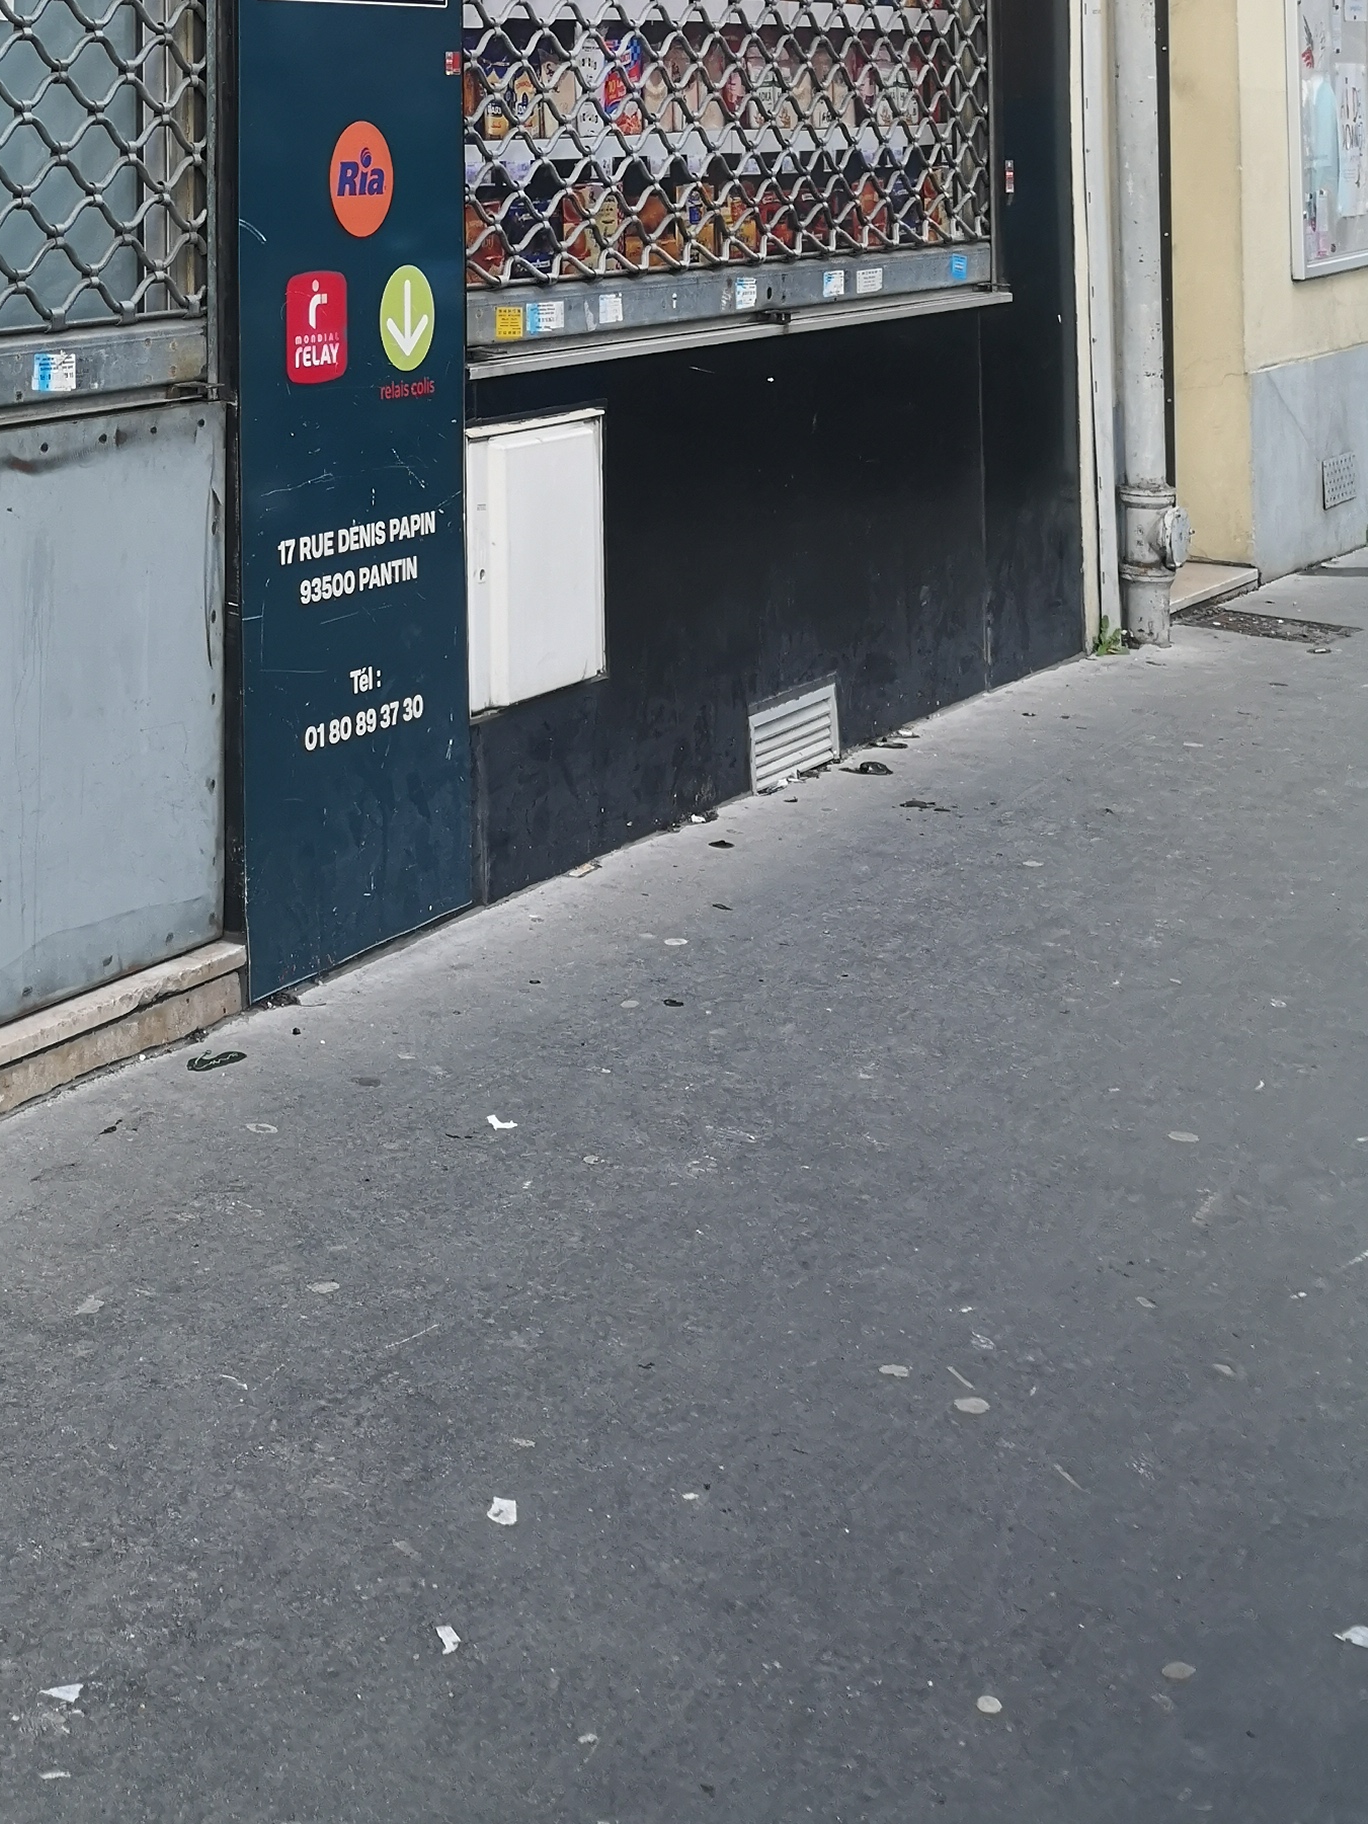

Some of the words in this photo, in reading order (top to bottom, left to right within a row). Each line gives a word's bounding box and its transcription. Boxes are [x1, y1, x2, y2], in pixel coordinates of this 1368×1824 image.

[336, 148, 386, 197] Ria
[294, 332, 340, 345] MONDIAL
[294, 343, 340, 368] RELAY
[380, 380, 410, 401] relais
[411, 376, 435, 397] colis
[277, 538, 296, 566] 17
[299, 531, 334, 562] RUE
[338, 519, 386, 554] DENIS
[389, 510, 436, 543] PAPIN
[300, 570, 355, 605] 93500
[359, 555, 418, 592] PANTIN
[349, 665, 373, 694] Tél
[304, 722, 325, 752] 01
[329, 716, 353, 746] 80
[356, 708, 377, 737] 89
[380, 700, 400, 729] 37
[402, 694, 424, 722] 30
